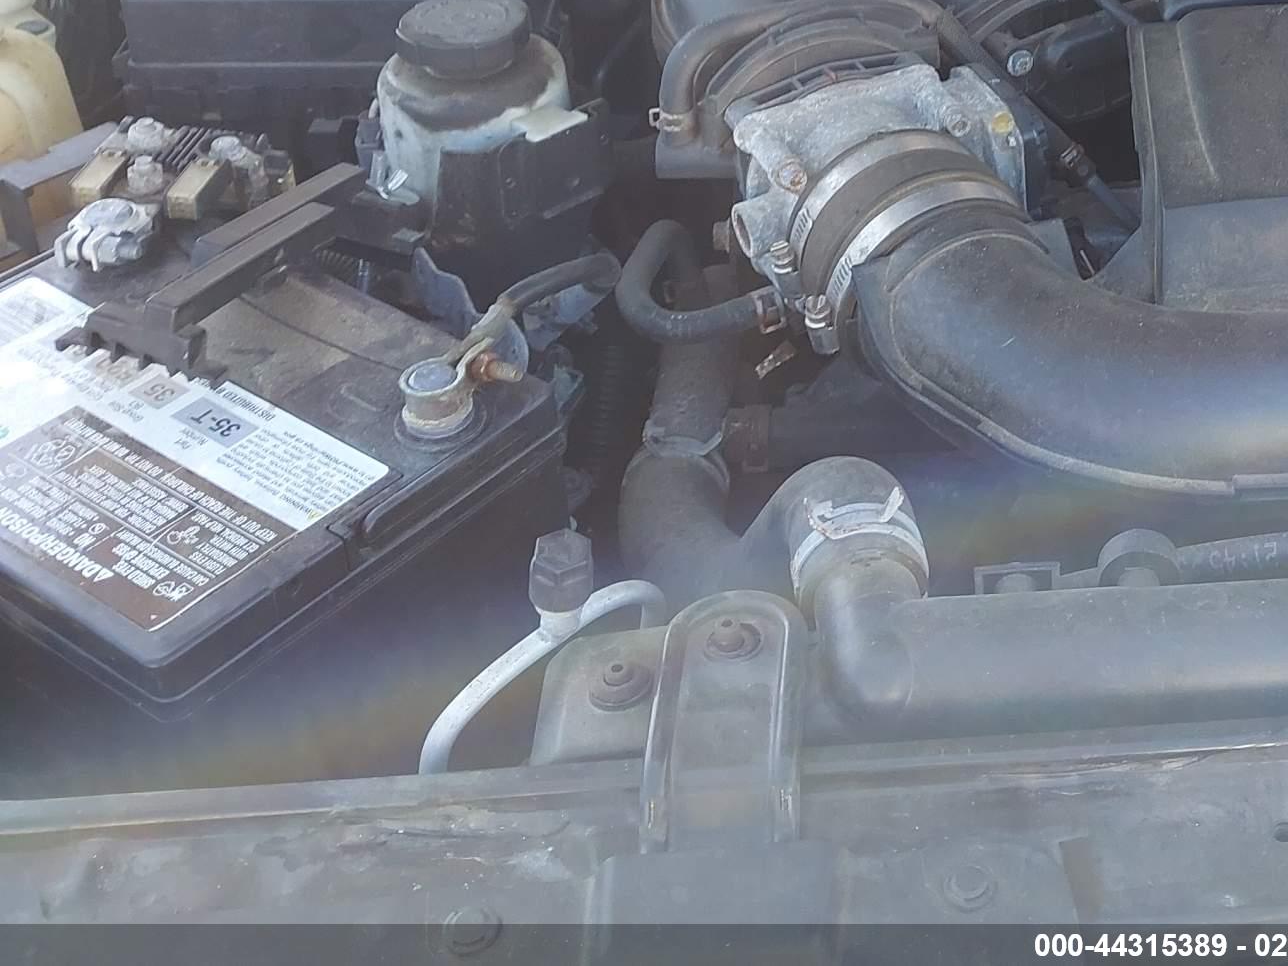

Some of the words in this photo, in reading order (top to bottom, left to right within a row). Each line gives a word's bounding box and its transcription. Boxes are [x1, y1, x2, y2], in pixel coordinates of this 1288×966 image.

[140, 381, 177, 403] 35
[220, 390, 276, 422] DISTRIBUTED
[188, 406, 243, 439] 35-T
[172, 437, 193, 450] Part
[176, 427, 209, 446] Number
[133, 457, 155, 471] NOT
[144, 464, 165, 477] DO
[187, 488, 207, 501] OF
[196, 494, 227, 512] REACH
[216, 505, 240, 520] THE
[229, 513, 250, 525] OF
[203, 518, 226, 533] HELP
[239, 518, 263, 533] OUT
[71, 531, 98, 548] NO
[252, 526, 279, 542] KEEP
[226, 545, 250, 560] WITH
[240, 540, 261, 553] GET
[186, 550, 210, 564] EYES
[109, 559, 136, 576] EYES
[171, 562, 199, 579] CAUSE
[200, 558, 228, 575] FLUSH
[124, 569, 158, 589] SHIELD
[189, 573, 211, 586] CAN
